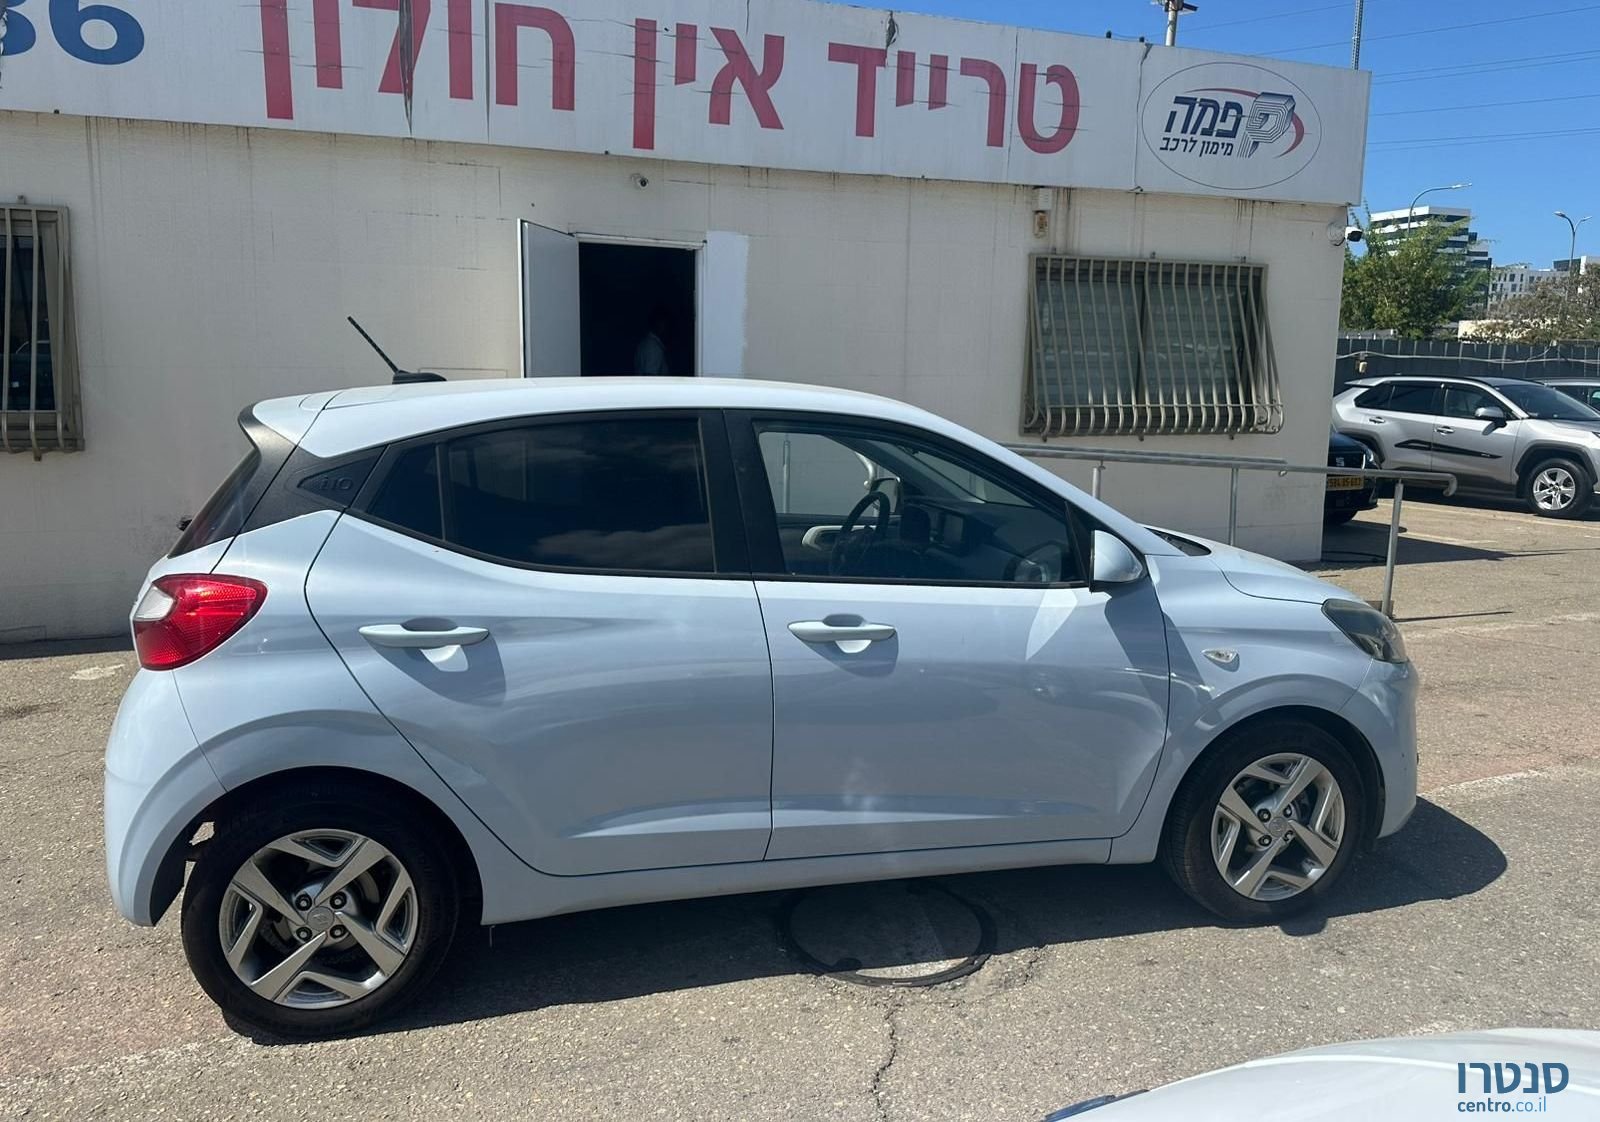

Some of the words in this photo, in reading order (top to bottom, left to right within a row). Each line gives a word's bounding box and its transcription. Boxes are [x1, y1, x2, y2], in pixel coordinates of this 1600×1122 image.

[633, 18, 785, 150] אין
[828, 42, 1081, 154] טרייד
[1159, 136, 1198, 153] לרכב
[1199, 139, 1234, 157] מימון
